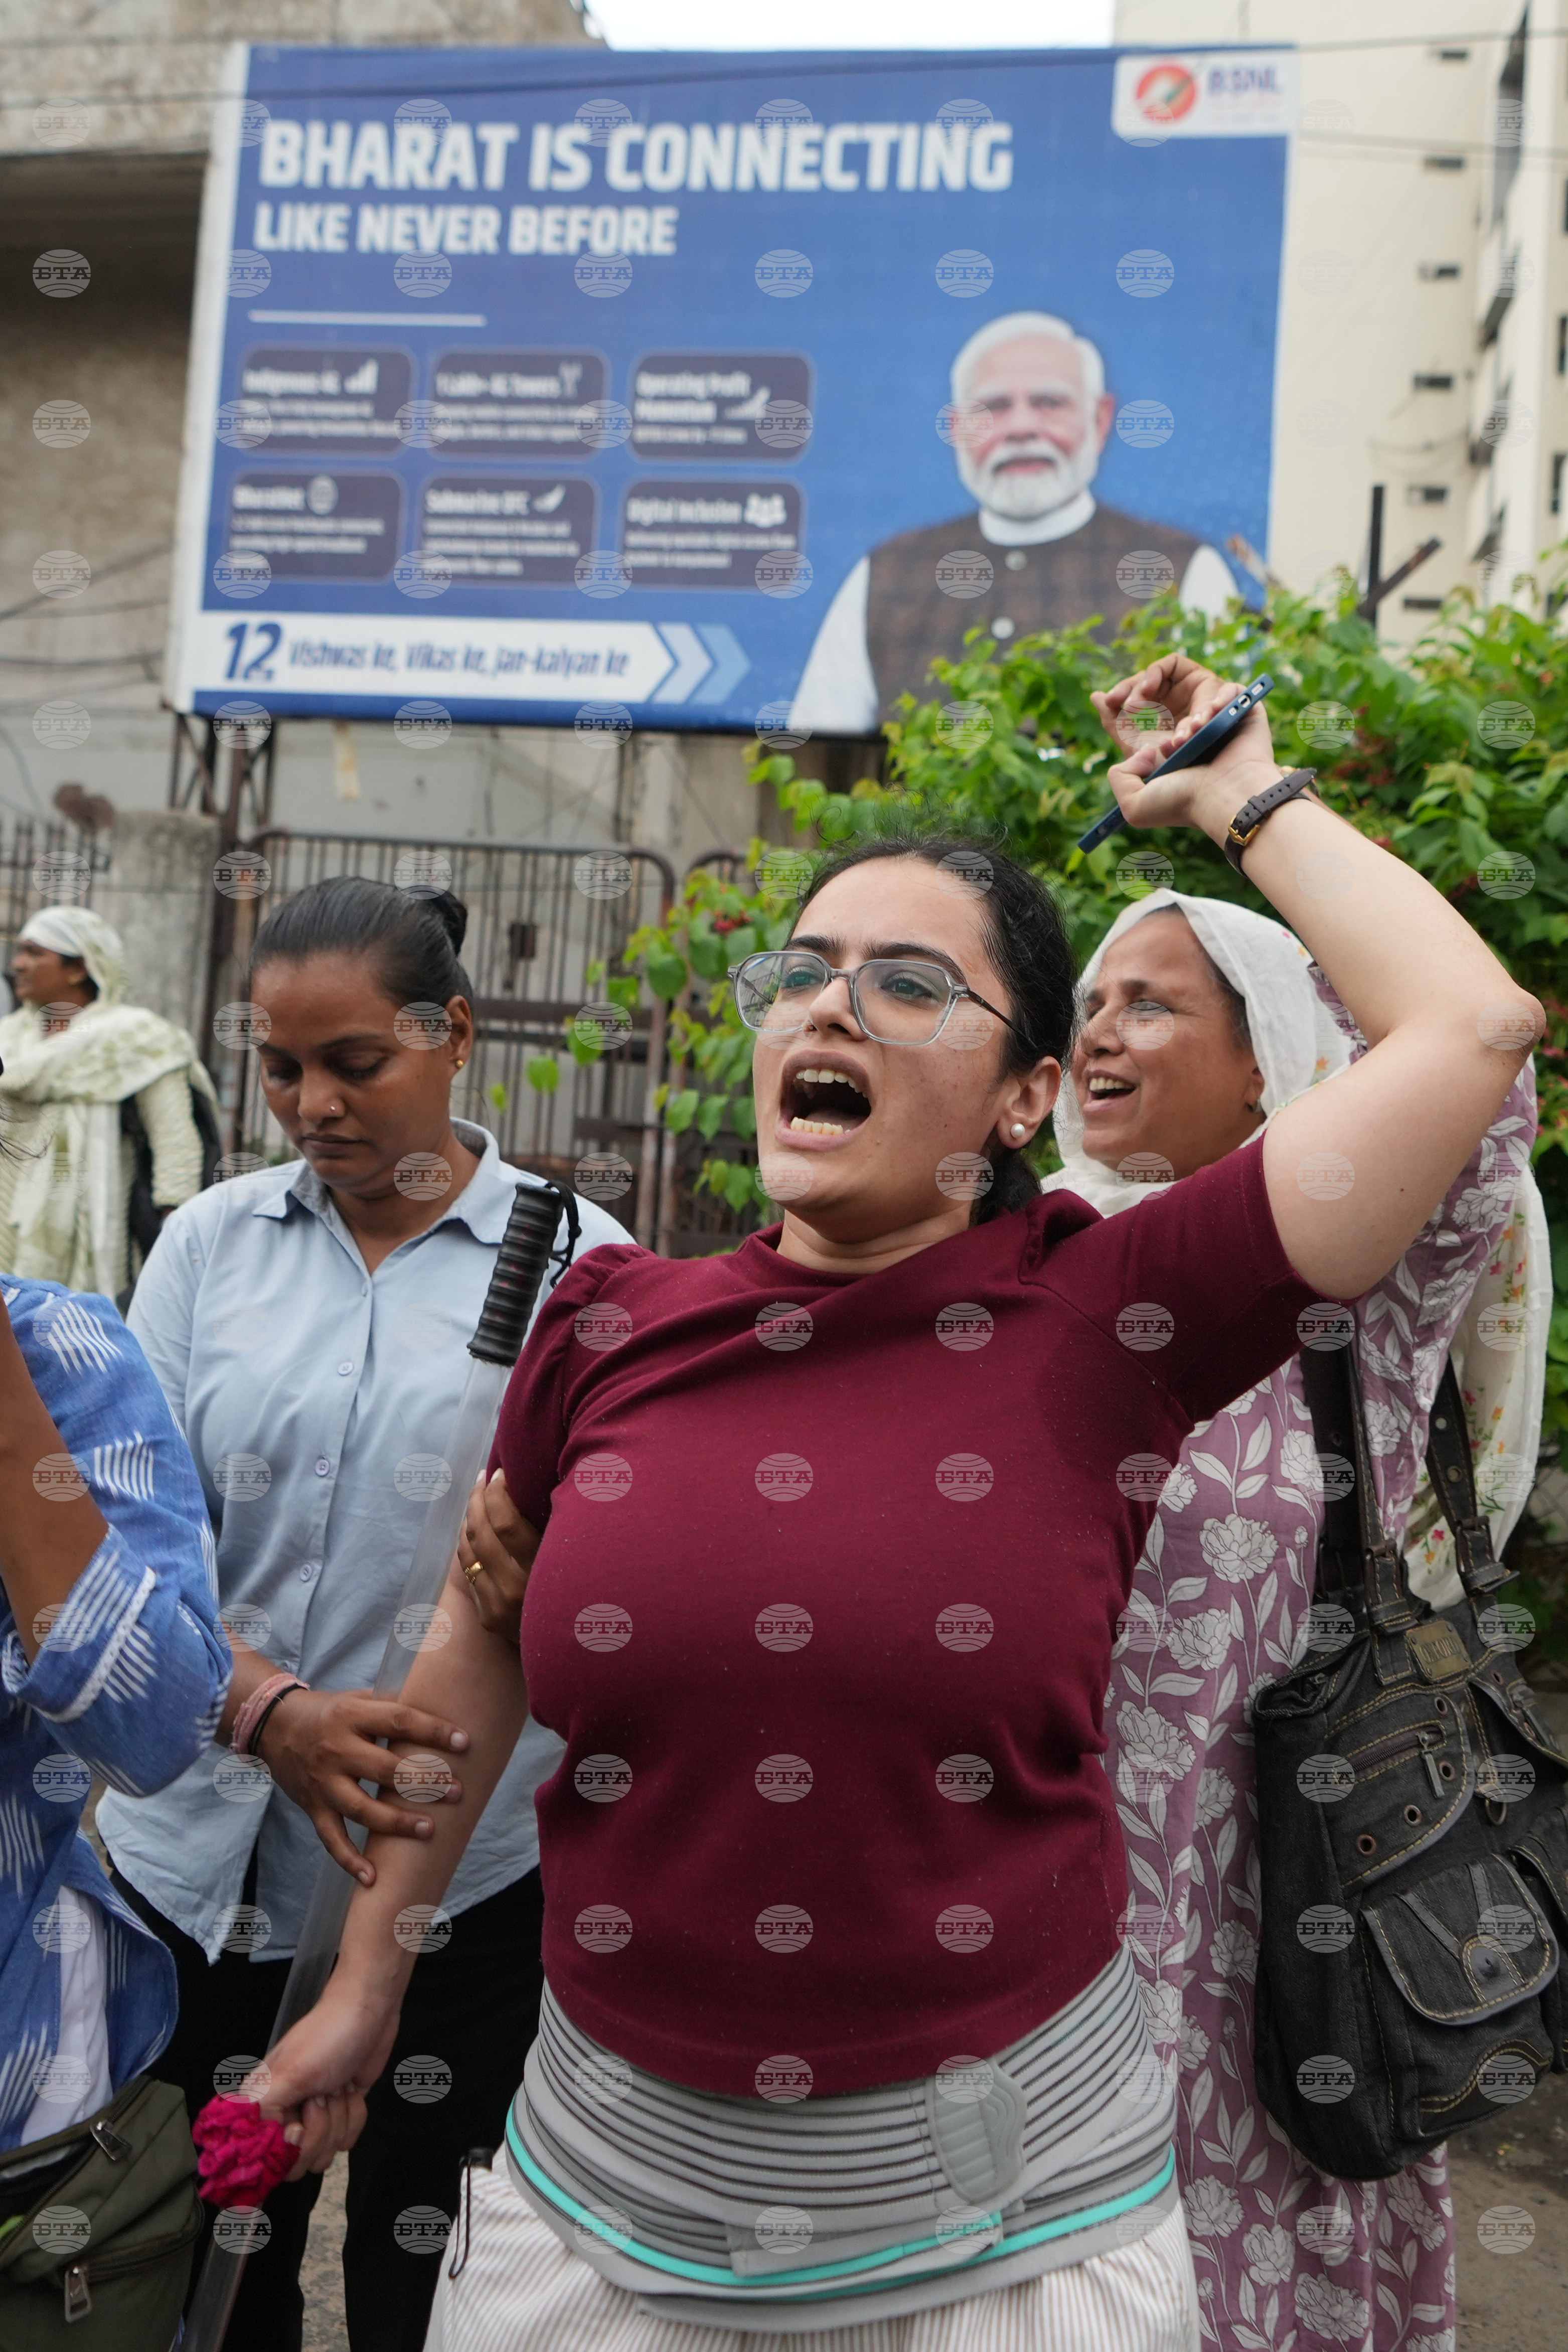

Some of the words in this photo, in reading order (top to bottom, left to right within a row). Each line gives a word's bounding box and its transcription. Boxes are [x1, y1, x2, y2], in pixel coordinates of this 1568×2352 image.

[259, 120, 520, 191] BHARAT
[529, 121, 591, 192] IS
[605, 122, 1012, 193] CONNECTING
[253, 202, 350, 252] LIKE
[356, 203, 500, 254] NEVER
[508, 206, 679, 256] BEFORE
[224, 620, 283, 681] 12
[1419, 1636, 1462, 1664] OXFORD
